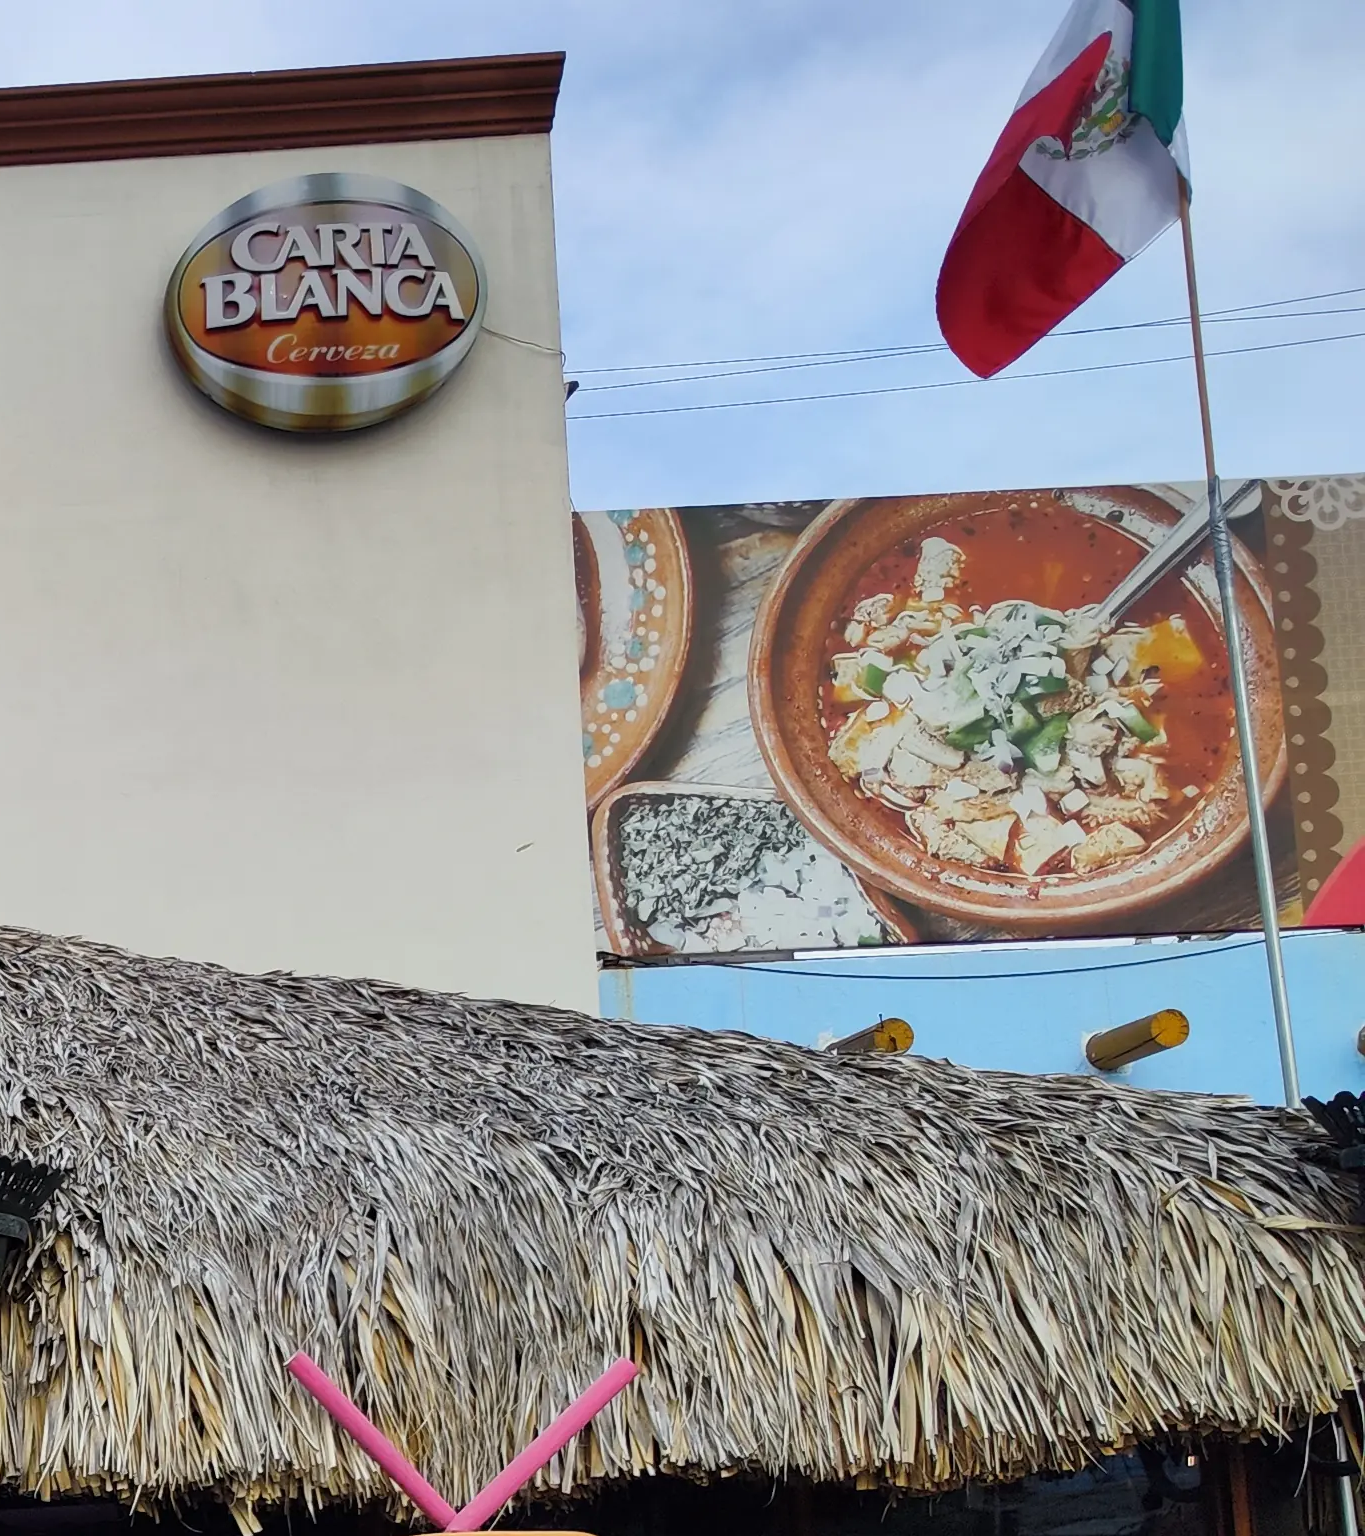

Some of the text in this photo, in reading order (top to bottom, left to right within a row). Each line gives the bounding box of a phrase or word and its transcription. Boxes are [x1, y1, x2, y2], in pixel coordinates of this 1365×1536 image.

[230, 222, 436, 272] CARTA
[199, 268, 466, 331] BLANCA
[266, 334, 399, 365] Cerveza
